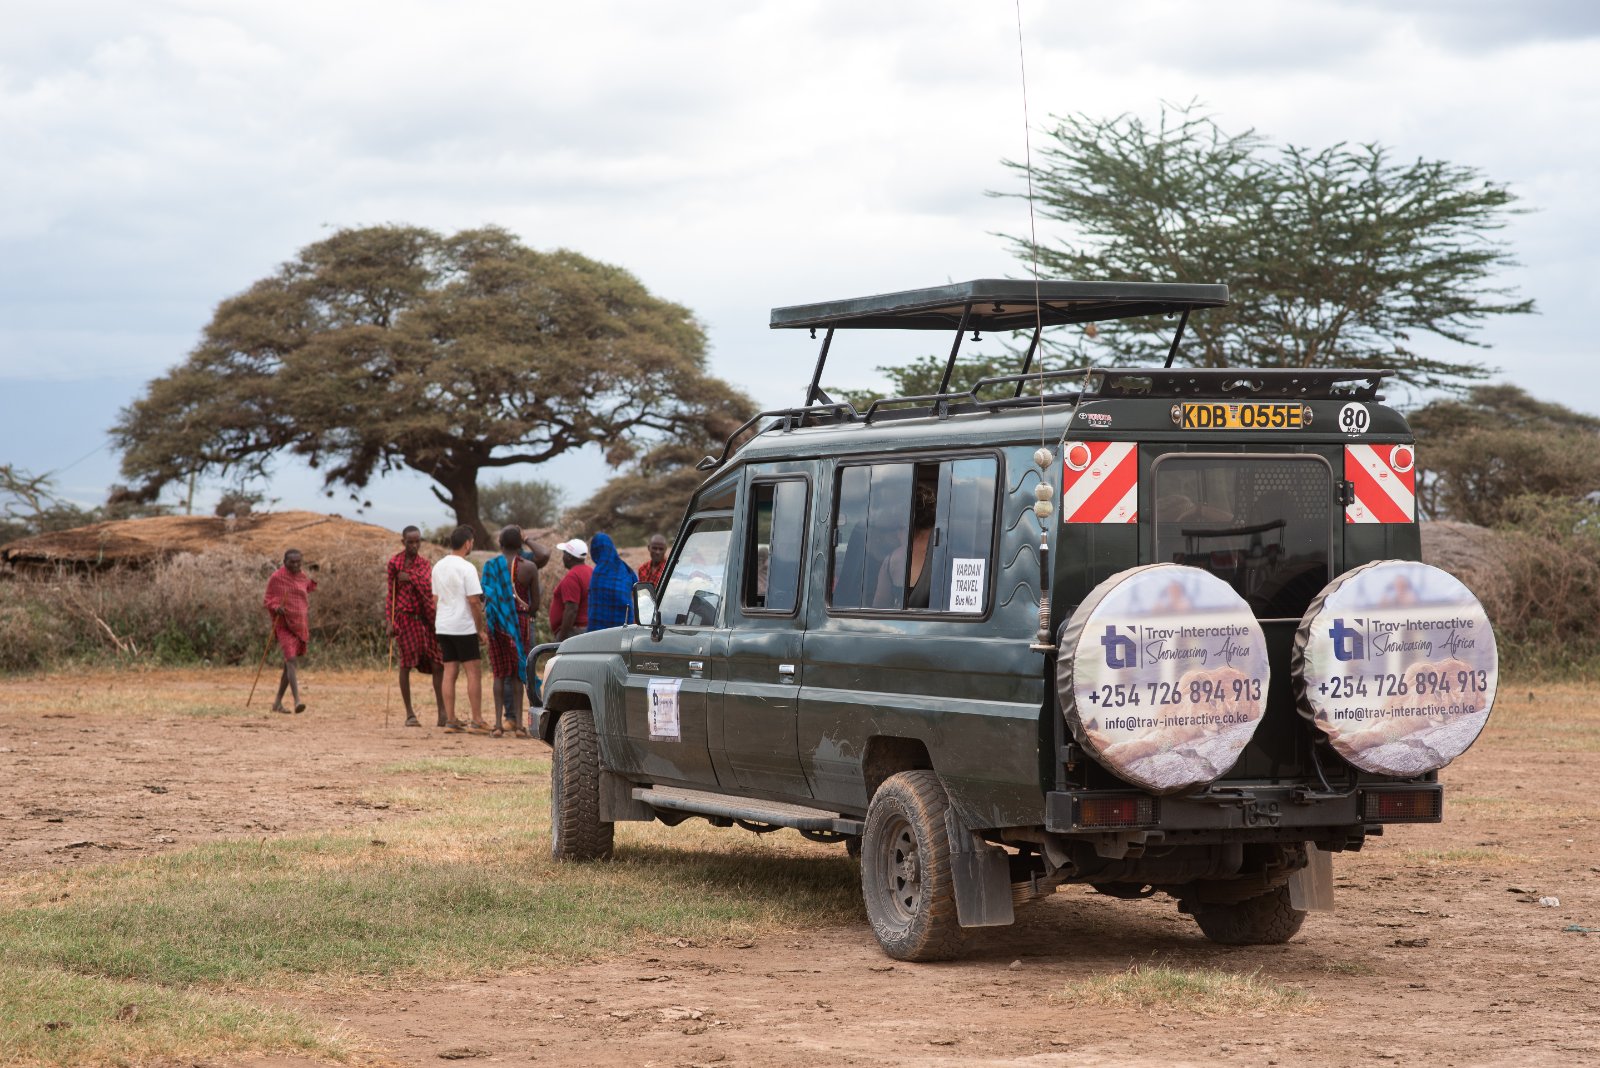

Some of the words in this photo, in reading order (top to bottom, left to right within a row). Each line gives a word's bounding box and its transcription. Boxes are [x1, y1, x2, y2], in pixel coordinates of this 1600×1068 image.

[1183, 405, 1227, 428] KDB
[1240, 405, 1301, 428] 055E
[1343, 407, 1367, 428] 80
[956, 563, 982, 576] VARDAN
[955, 580, 978, 592] TRAVEL
[955, 595, 965, 606] Bus
[965, 595, 977, 606] No.1
[1145, 624, 1249, 639] Trav-Interactive
[1372, 617, 1474, 632] Trav-Interactive
[1145, 639, 1208, 665] Showcasing
[1213, 636, 1250, 668] Africa
[1372, 632, 1432, 657] Showcasing
[1438, 629, 1475, 661] Africa
[1088, 683, 1140, 708] +254
[1147, 681, 1182, 705] 726
[1189, 680, 1226, 704] 894
[1232, 678, 1261, 701] 913
[1318, 676, 1367, 698] +254
[1374, 673, 1408, 696] 726
[1415, 671, 1450, 695] 894
[1457, 669, 1488, 692] 913
[1105, 712, 1249, 731] info@trav-interactive.co.ke
[1334, 703, 1475, 721] info@trav-interactive.co.ke
